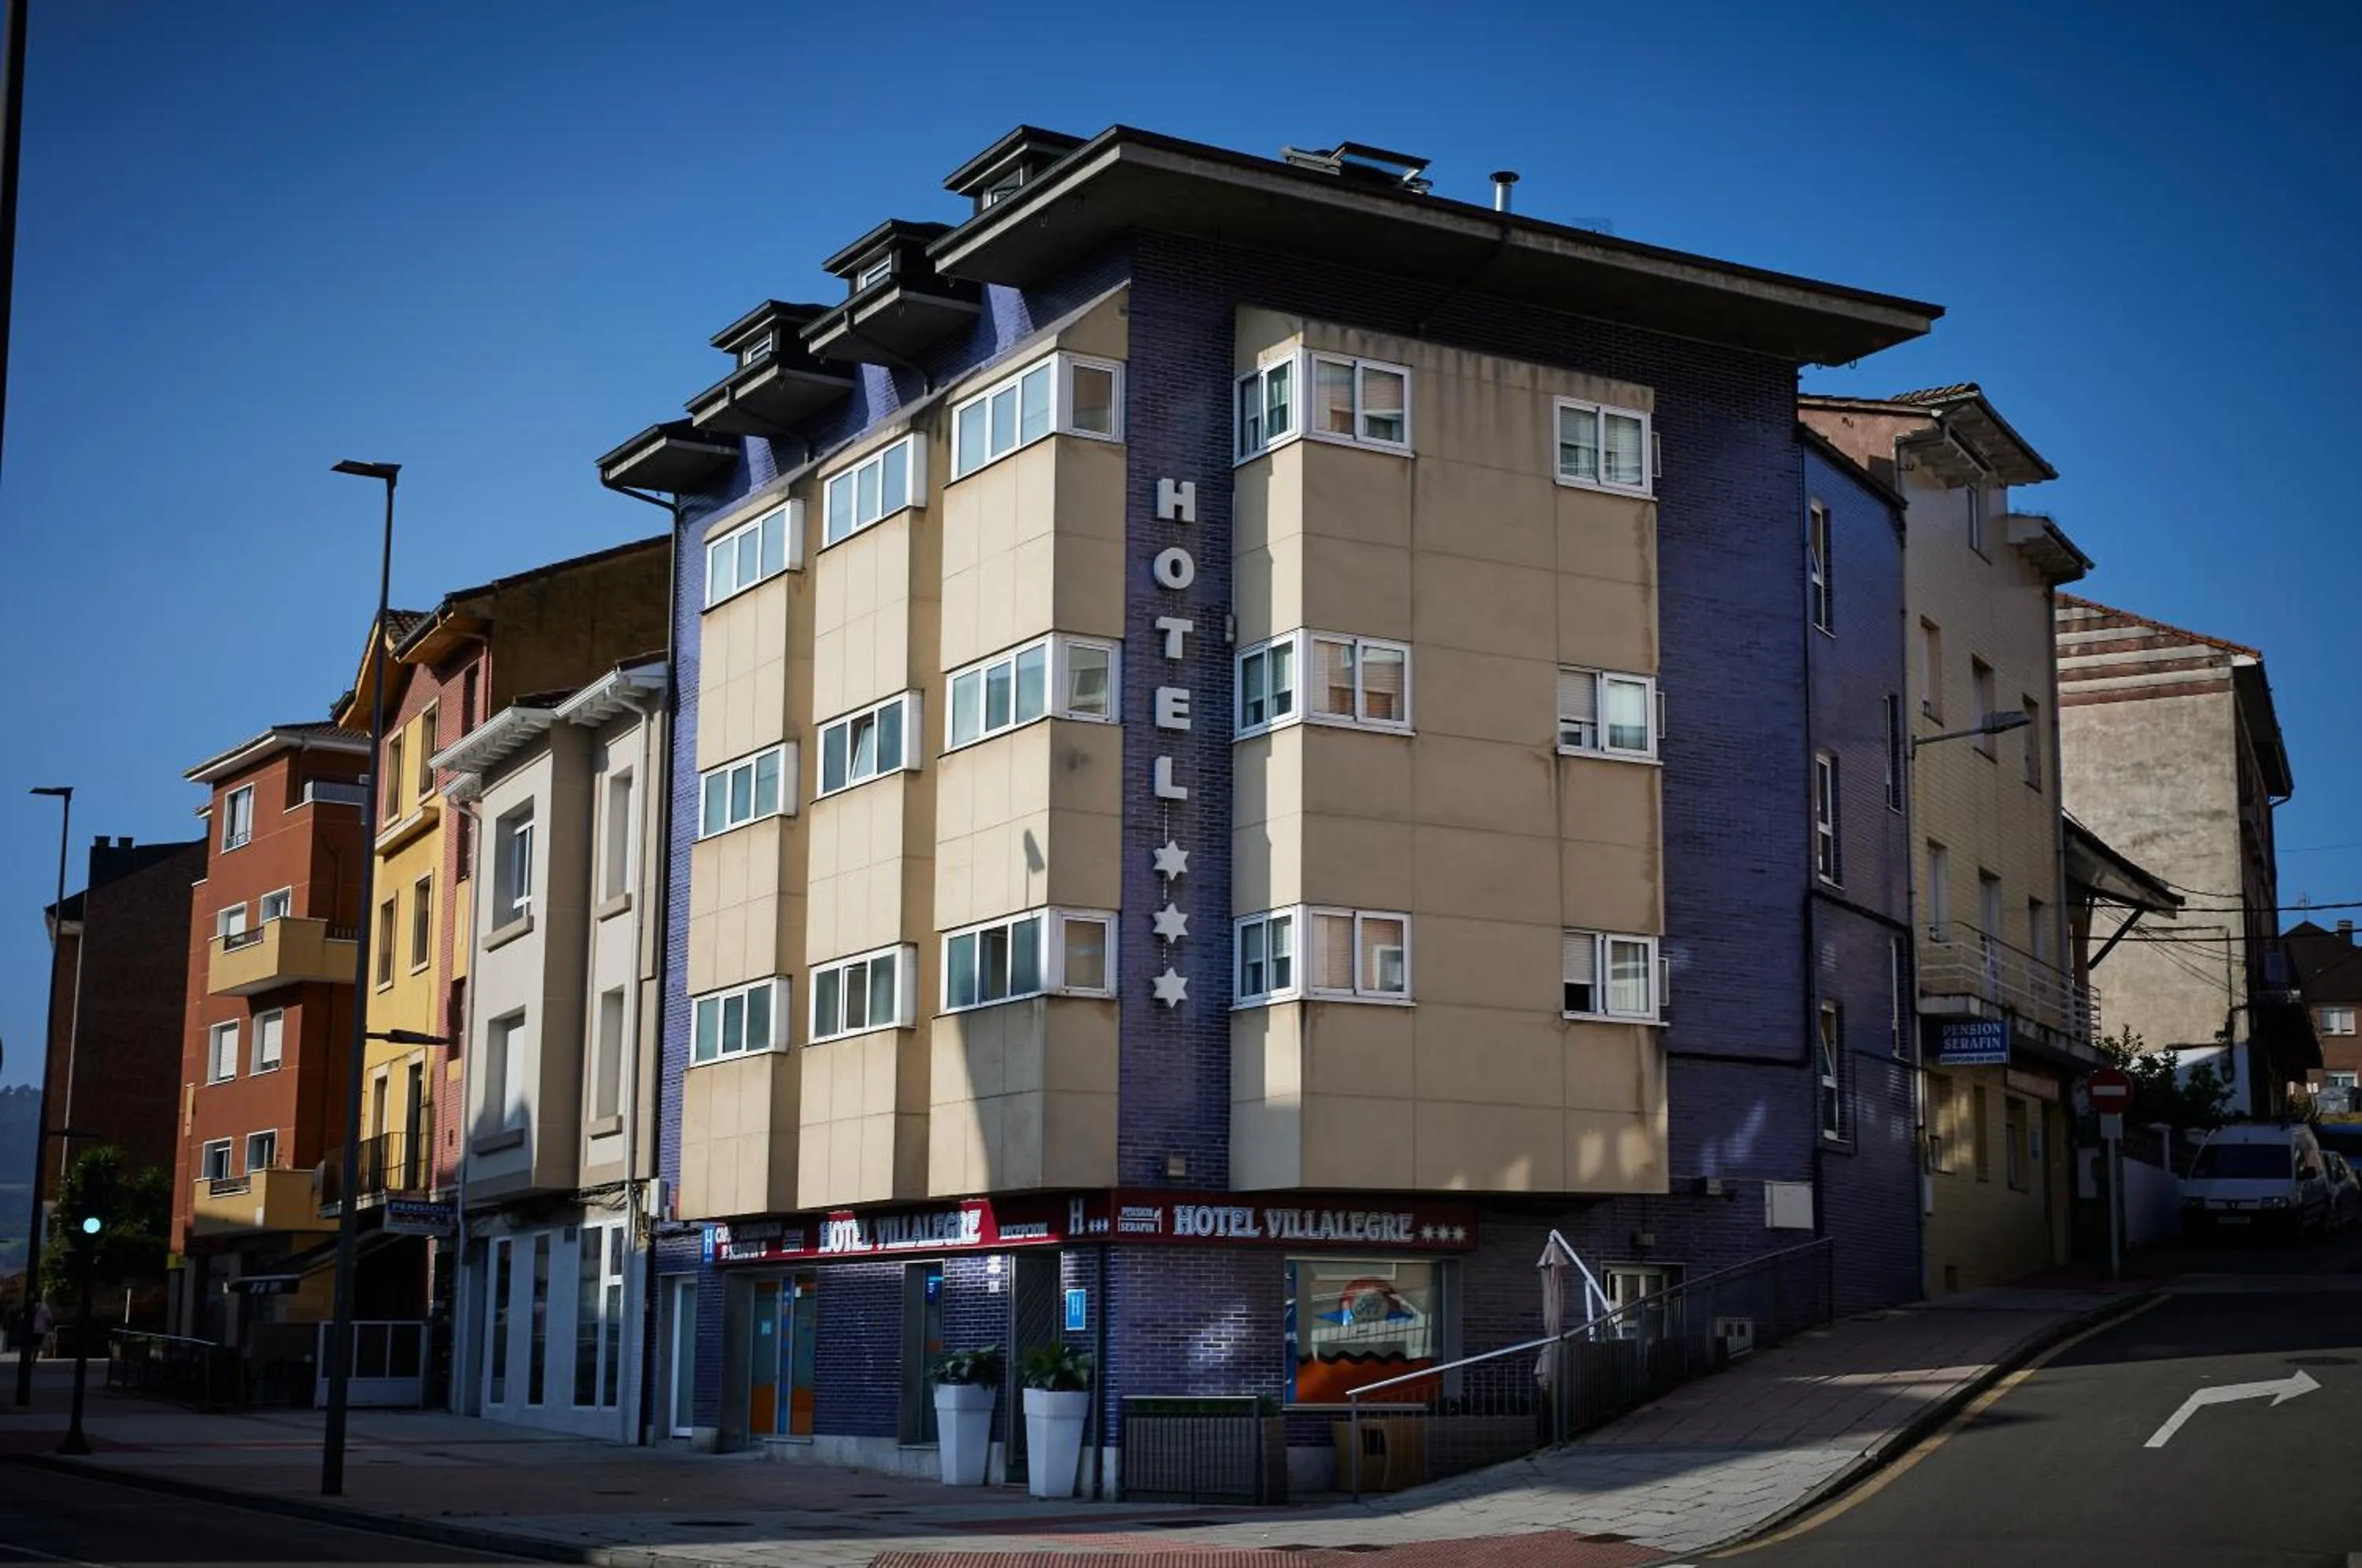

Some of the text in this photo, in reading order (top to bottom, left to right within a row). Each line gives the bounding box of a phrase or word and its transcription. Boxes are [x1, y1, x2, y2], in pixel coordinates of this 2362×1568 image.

[1153, 478, 1196, 801] HOTEL
[1942, 1022, 2002, 1037] PENSION
[1942, 1036, 2001, 1051] SERAFIN
[818, 1219, 872, 1253] HOTEL
[875, 1209, 982, 1251] VILLALEGRE
[1172, 1204, 1415, 1243] HOTEL VILLALEGRE
